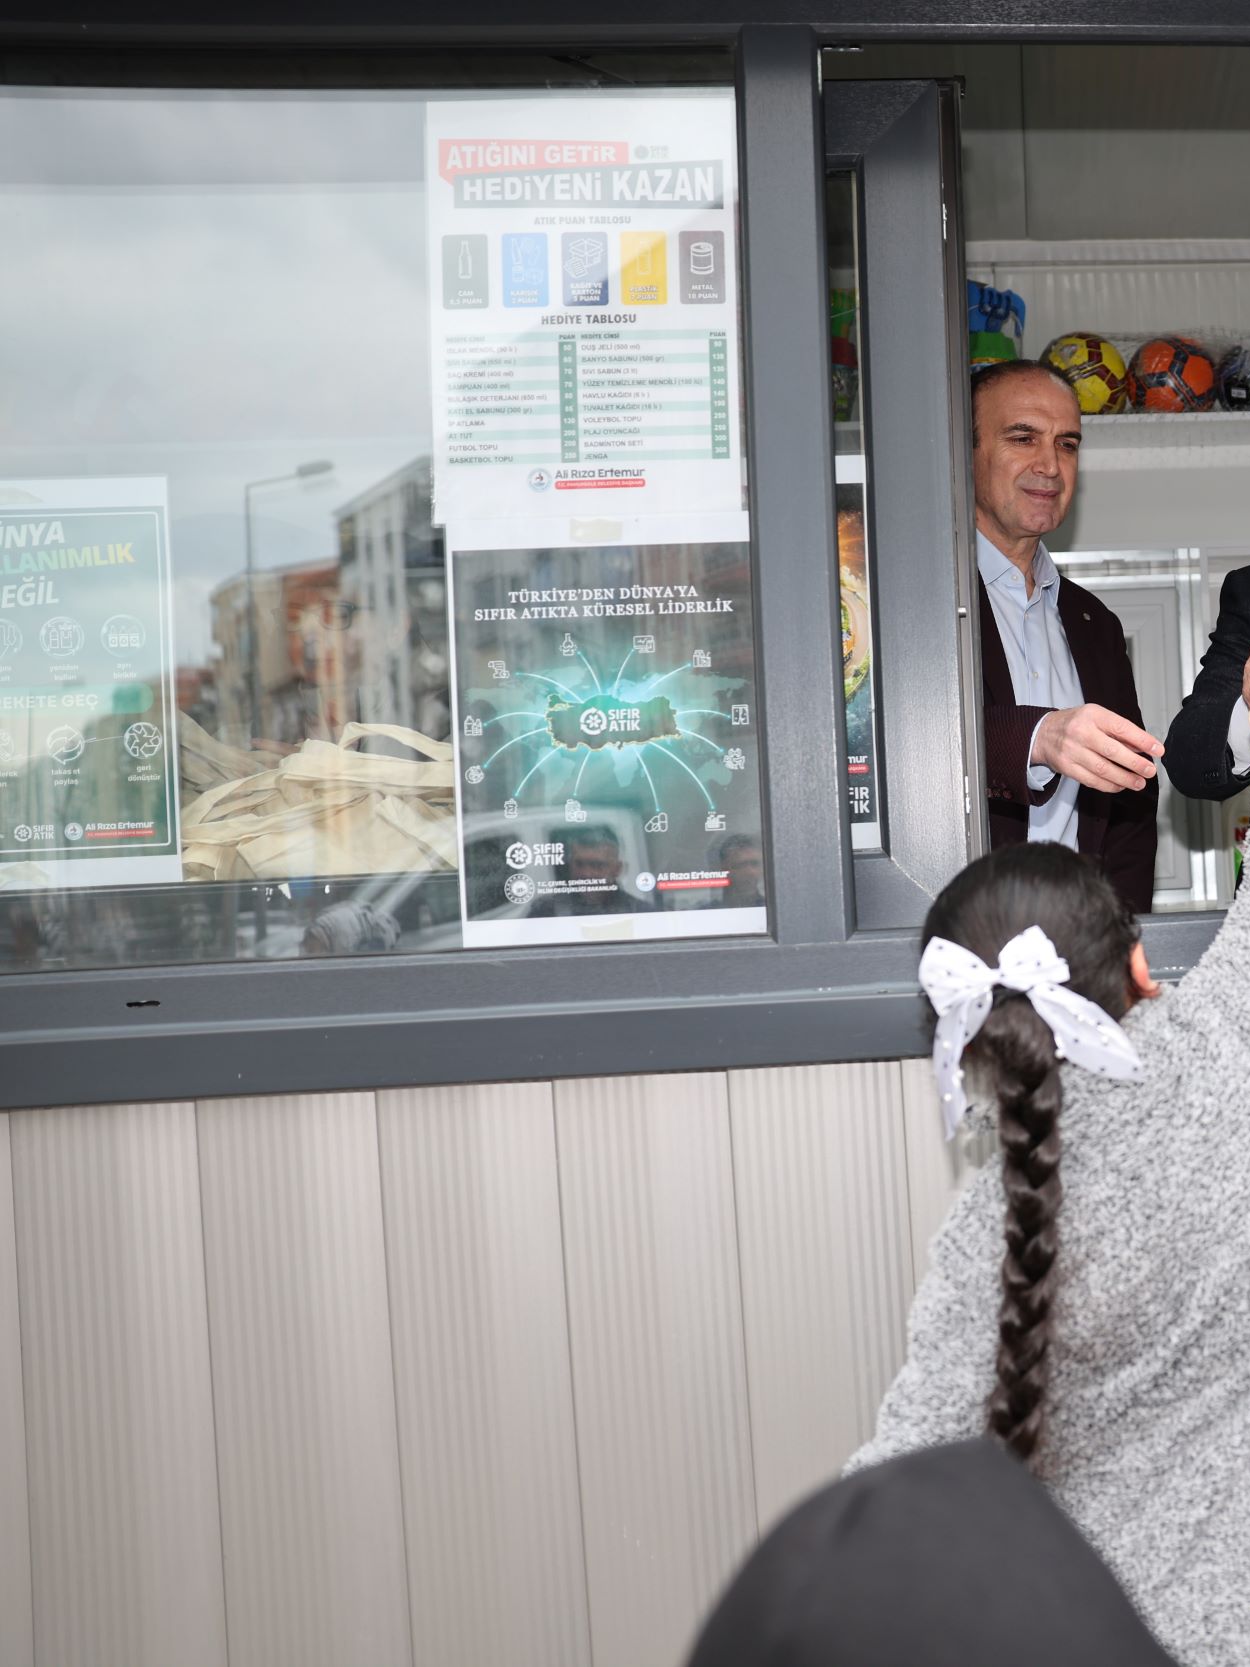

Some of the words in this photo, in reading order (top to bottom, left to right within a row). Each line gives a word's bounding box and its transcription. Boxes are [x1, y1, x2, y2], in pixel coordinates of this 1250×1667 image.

[446, 140, 536, 169] ATIĞINI
[613, 166, 714, 201] KAZAN
[533, 216, 556, 225] ATIK
[558, 216, 586, 225] PUAN
[588, 215, 632, 225] TABLOSU
[458, 289, 474, 297] CAM
[580, 294, 600, 302] PUAN
[698, 291, 718, 299] PUAN
[462, 297, 482, 305] PUAN
[541, 313, 582, 325] HEDİYE
[586, 313, 637, 325] TABLOSU
[555, 470, 568, 479] Ali
[474, 607, 517, 621] SIFIR
[520, 605, 580, 619] ATIKTA
[583, 602, 654, 617] KÜRESEL
[659, 598, 733, 615] LİDERLİK
[0, 695, 57, 709] EKETE
[62, 693, 99, 711] GEÇ
[608, 708, 640, 721] SIFIR
[609, 719, 641, 732] ATIK
[32, 825, 54, 833] SIFIR
[85, 823, 96, 831] Ali
[33, 832, 55, 841] ATIK
[533, 842, 565, 855] SIFIR
[534, 853, 566, 867] ATIK
[658, 872, 669, 881] Ali
